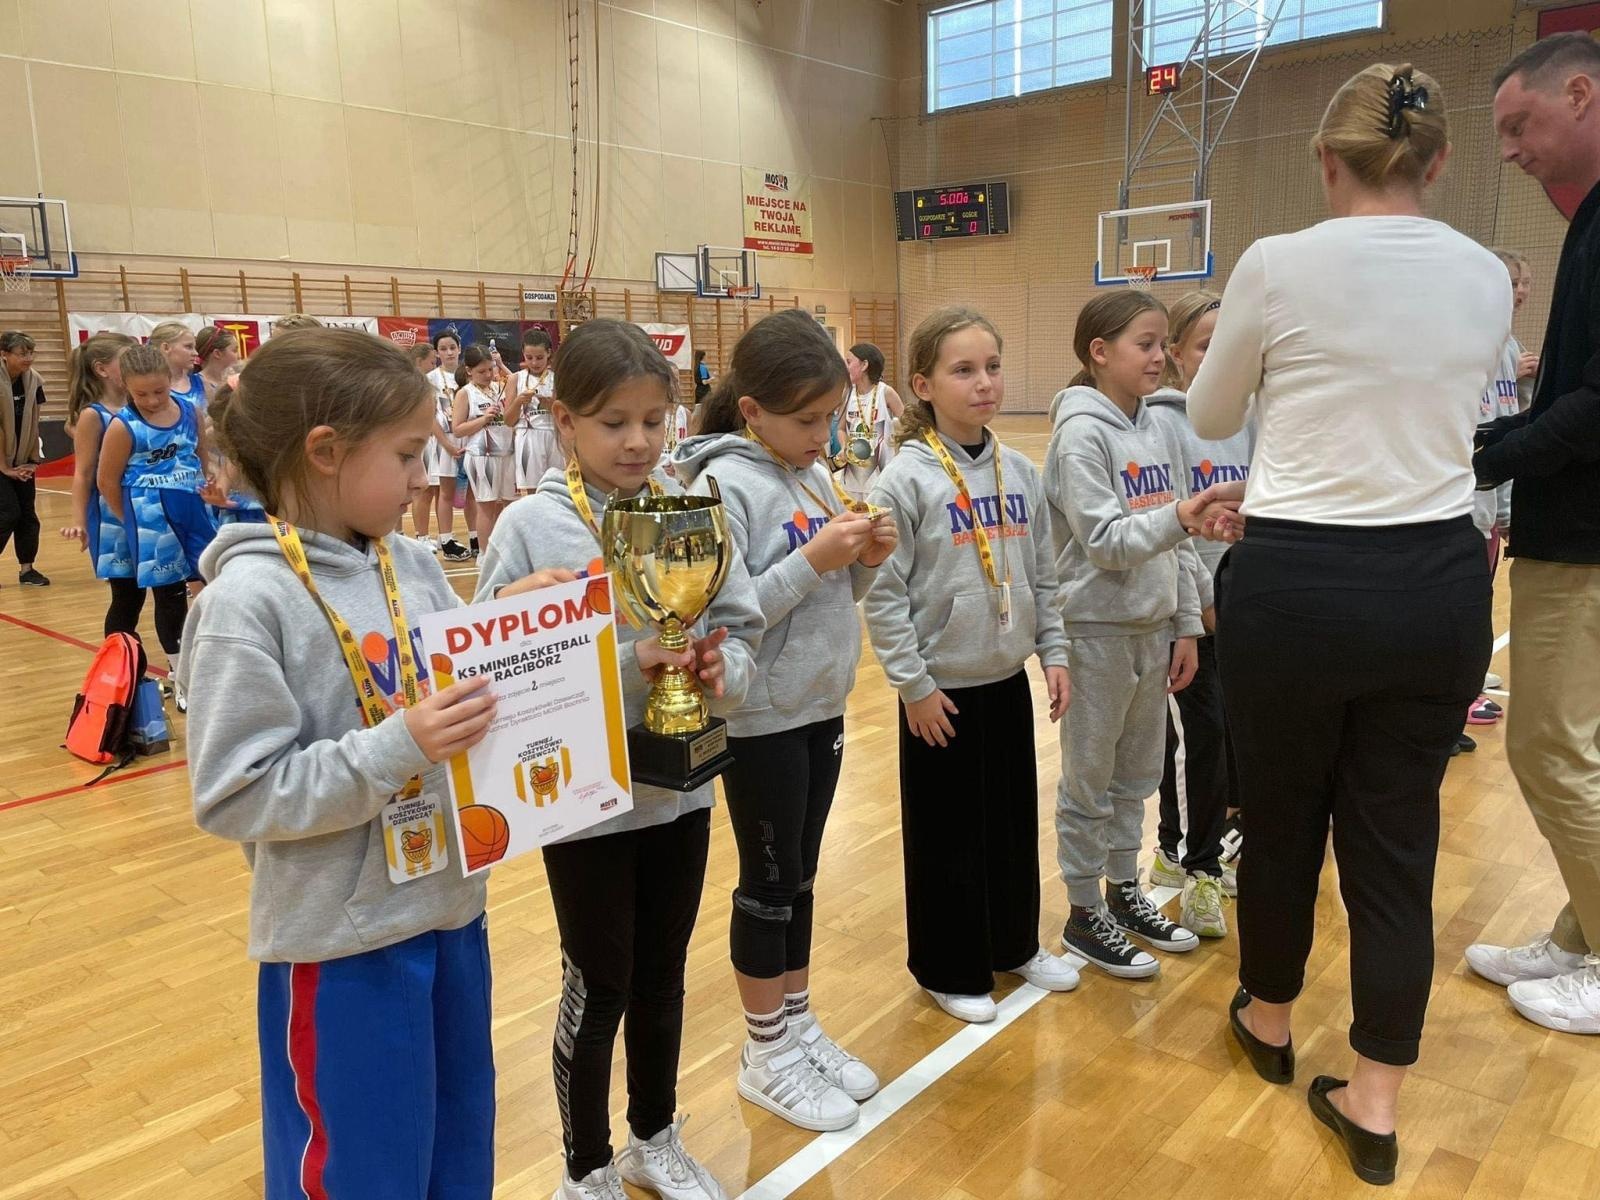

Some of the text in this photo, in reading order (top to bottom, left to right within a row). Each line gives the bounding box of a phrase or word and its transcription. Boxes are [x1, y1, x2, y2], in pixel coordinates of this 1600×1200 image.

[1150, 66, 1177, 90] 24
[746, 195, 807, 212] MIEJSCE NA
[760, 209, 796, 225] TWOJĄ
[754, 221, 802, 238] REKLAMĘ
[923, 224, 932, 236] 0
[970, 221, 977, 233] 0
[524, 291, 556, 301] GOSPODARZE
[147, 442, 178, 465] 30
[946, 493, 1028, 534] MINI
[445, 595, 594, 655] DYPLOM
[457, 634, 591, 680] KS MINIBASKETBALL
[531, 680, 538, 691] 2
[517, 738, 563, 759] KOSZYKÓWKI
[526, 736, 554, 750] TURNIEJ
[521, 745, 561, 763] DZIEWCZĄT
[397, 799, 426, 812] TURNIEJ
[392, 810, 433, 826] DZIEWCZĄT
